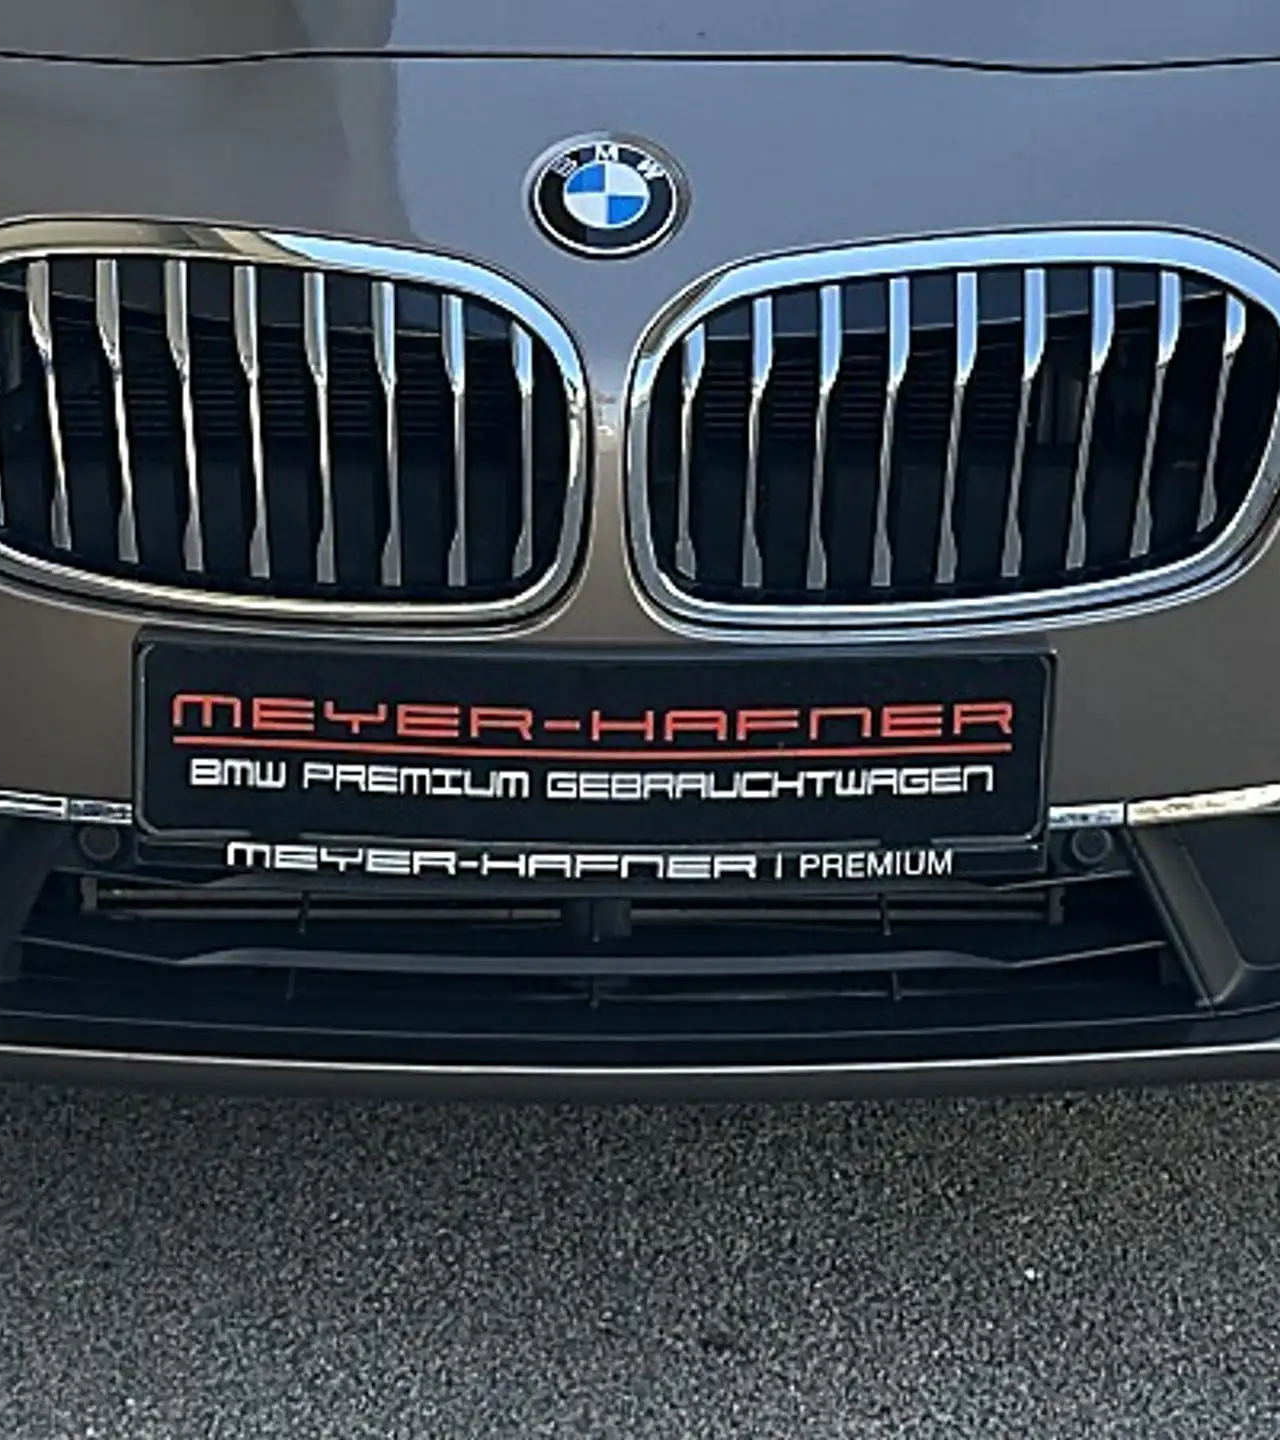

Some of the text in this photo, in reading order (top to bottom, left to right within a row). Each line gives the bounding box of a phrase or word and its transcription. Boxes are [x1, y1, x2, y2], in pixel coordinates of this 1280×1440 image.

[549, 142, 667, 180] BMW
[172, 693, 1013, 742] MEYER-HAFNER
[190, 758, 994, 799] BMW PREMIUM GEBRAUCHTWAGEN
[226, 841, 758, 879] MEYER-HAFNER
[799, 848, 953, 879] PREMIUM
